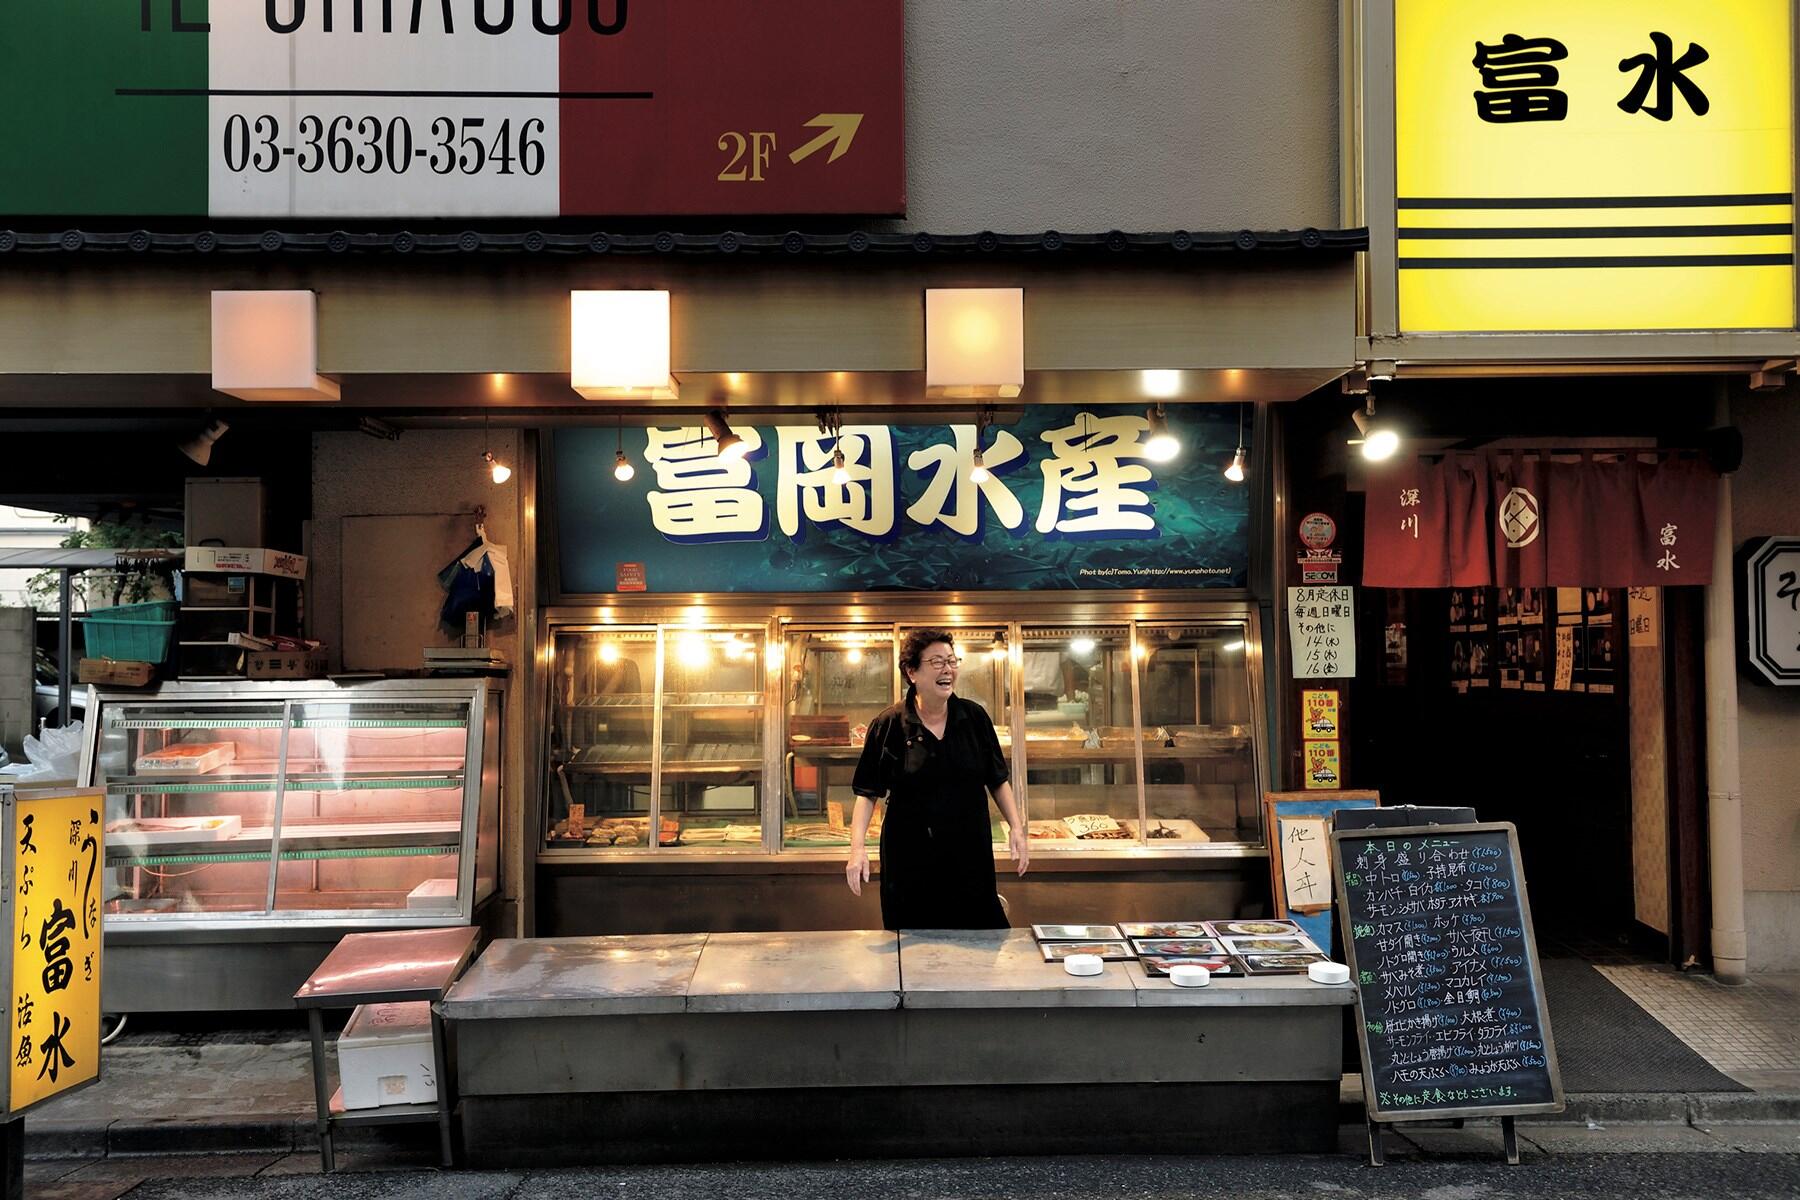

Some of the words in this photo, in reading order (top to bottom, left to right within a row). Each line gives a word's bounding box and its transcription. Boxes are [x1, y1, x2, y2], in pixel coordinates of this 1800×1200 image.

[1472, 31, 1709, 124] 富水
[223, 113, 546, 176] 03-3630-3546
[718, 132, 776, 181] 2F
[644, 412, 1157, 538] 富岡水産
[1400, 489, 1420, 538] 深川
[1656, 523, 1680, 571] 富水
[1296, 588, 1349, 602] 8月定休日
[1305, 572, 1335, 580] SECOM
[1294, 604, 1350, 618] 毎週日曜日
[1298, 622, 1336, 635] その他に
[68, 820, 81, 897] 深川
[1287, 827, 1317, 899] 他人丼
[1355, 848, 1470, 870] 刺身盛り合わせ
[1364, 839, 1460, 855] 本日のメニュー
[19, 814, 37, 950] 天ぷら
[81, 808, 99, 982] うなぎ
[37, 898, 76, 1084] 富水
[16, 996, 33, 1067] 活魚
